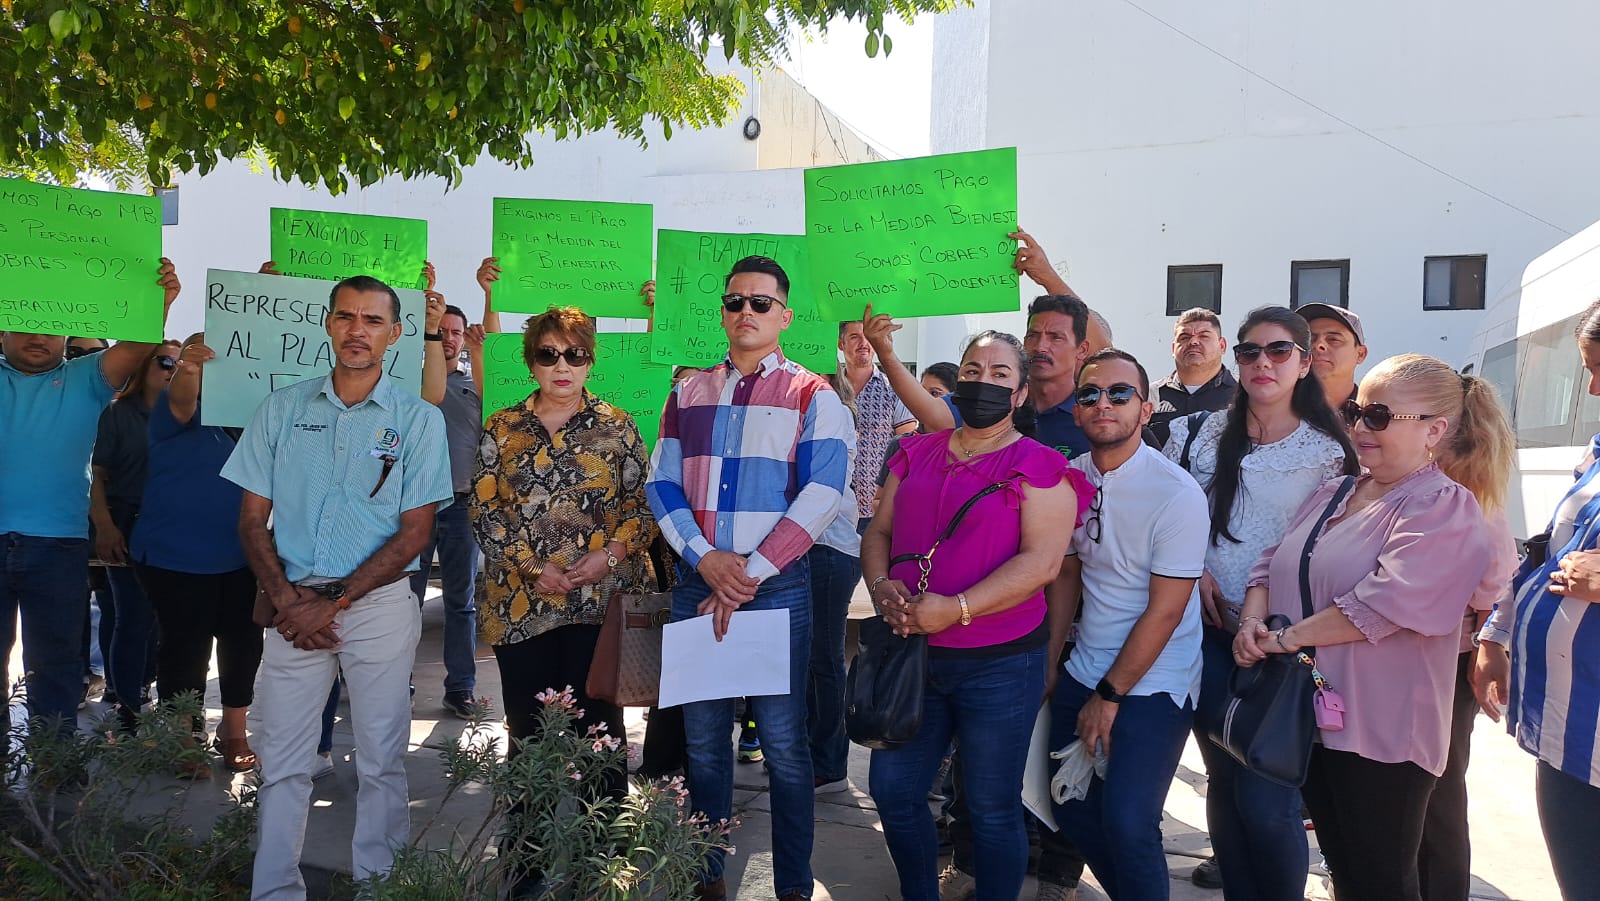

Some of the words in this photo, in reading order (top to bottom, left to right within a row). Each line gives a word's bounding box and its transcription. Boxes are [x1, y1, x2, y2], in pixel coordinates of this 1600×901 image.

[816, 175, 924, 202] SOLICITAMOS
[934, 168, 989, 190] PAGO
[45, 187, 102, 220] PAGO
[119, 203, 157, 224] MB
[500, 202, 562, 222] EXIGIMOS
[569, 213, 583, 223] EL
[585, 209, 627, 228] PAGO
[21, 218, 113, 248] PERSONAL
[814, 223, 835, 234] DE
[843, 215, 864, 233] LA
[870, 210, 937, 233] MEDIDA
[500, 232, 516, 241] DE
[525, 232, 540, 244] LA
[546, 231, 596, 248] MEDIDA
[599, 239, 622, 249] DEL
[289, 248, 332, 266] PAGO
[527, 249, 623, 271] BIENESTAR
[854, 252, 913, 269] SOMOS
[519, 275, 573, 290] SOMOS
[926, 272, 1018, 291] DOCENTES
[0, 314, 109, 333] DOCENTES
[227, 330, 261, 360] AL
